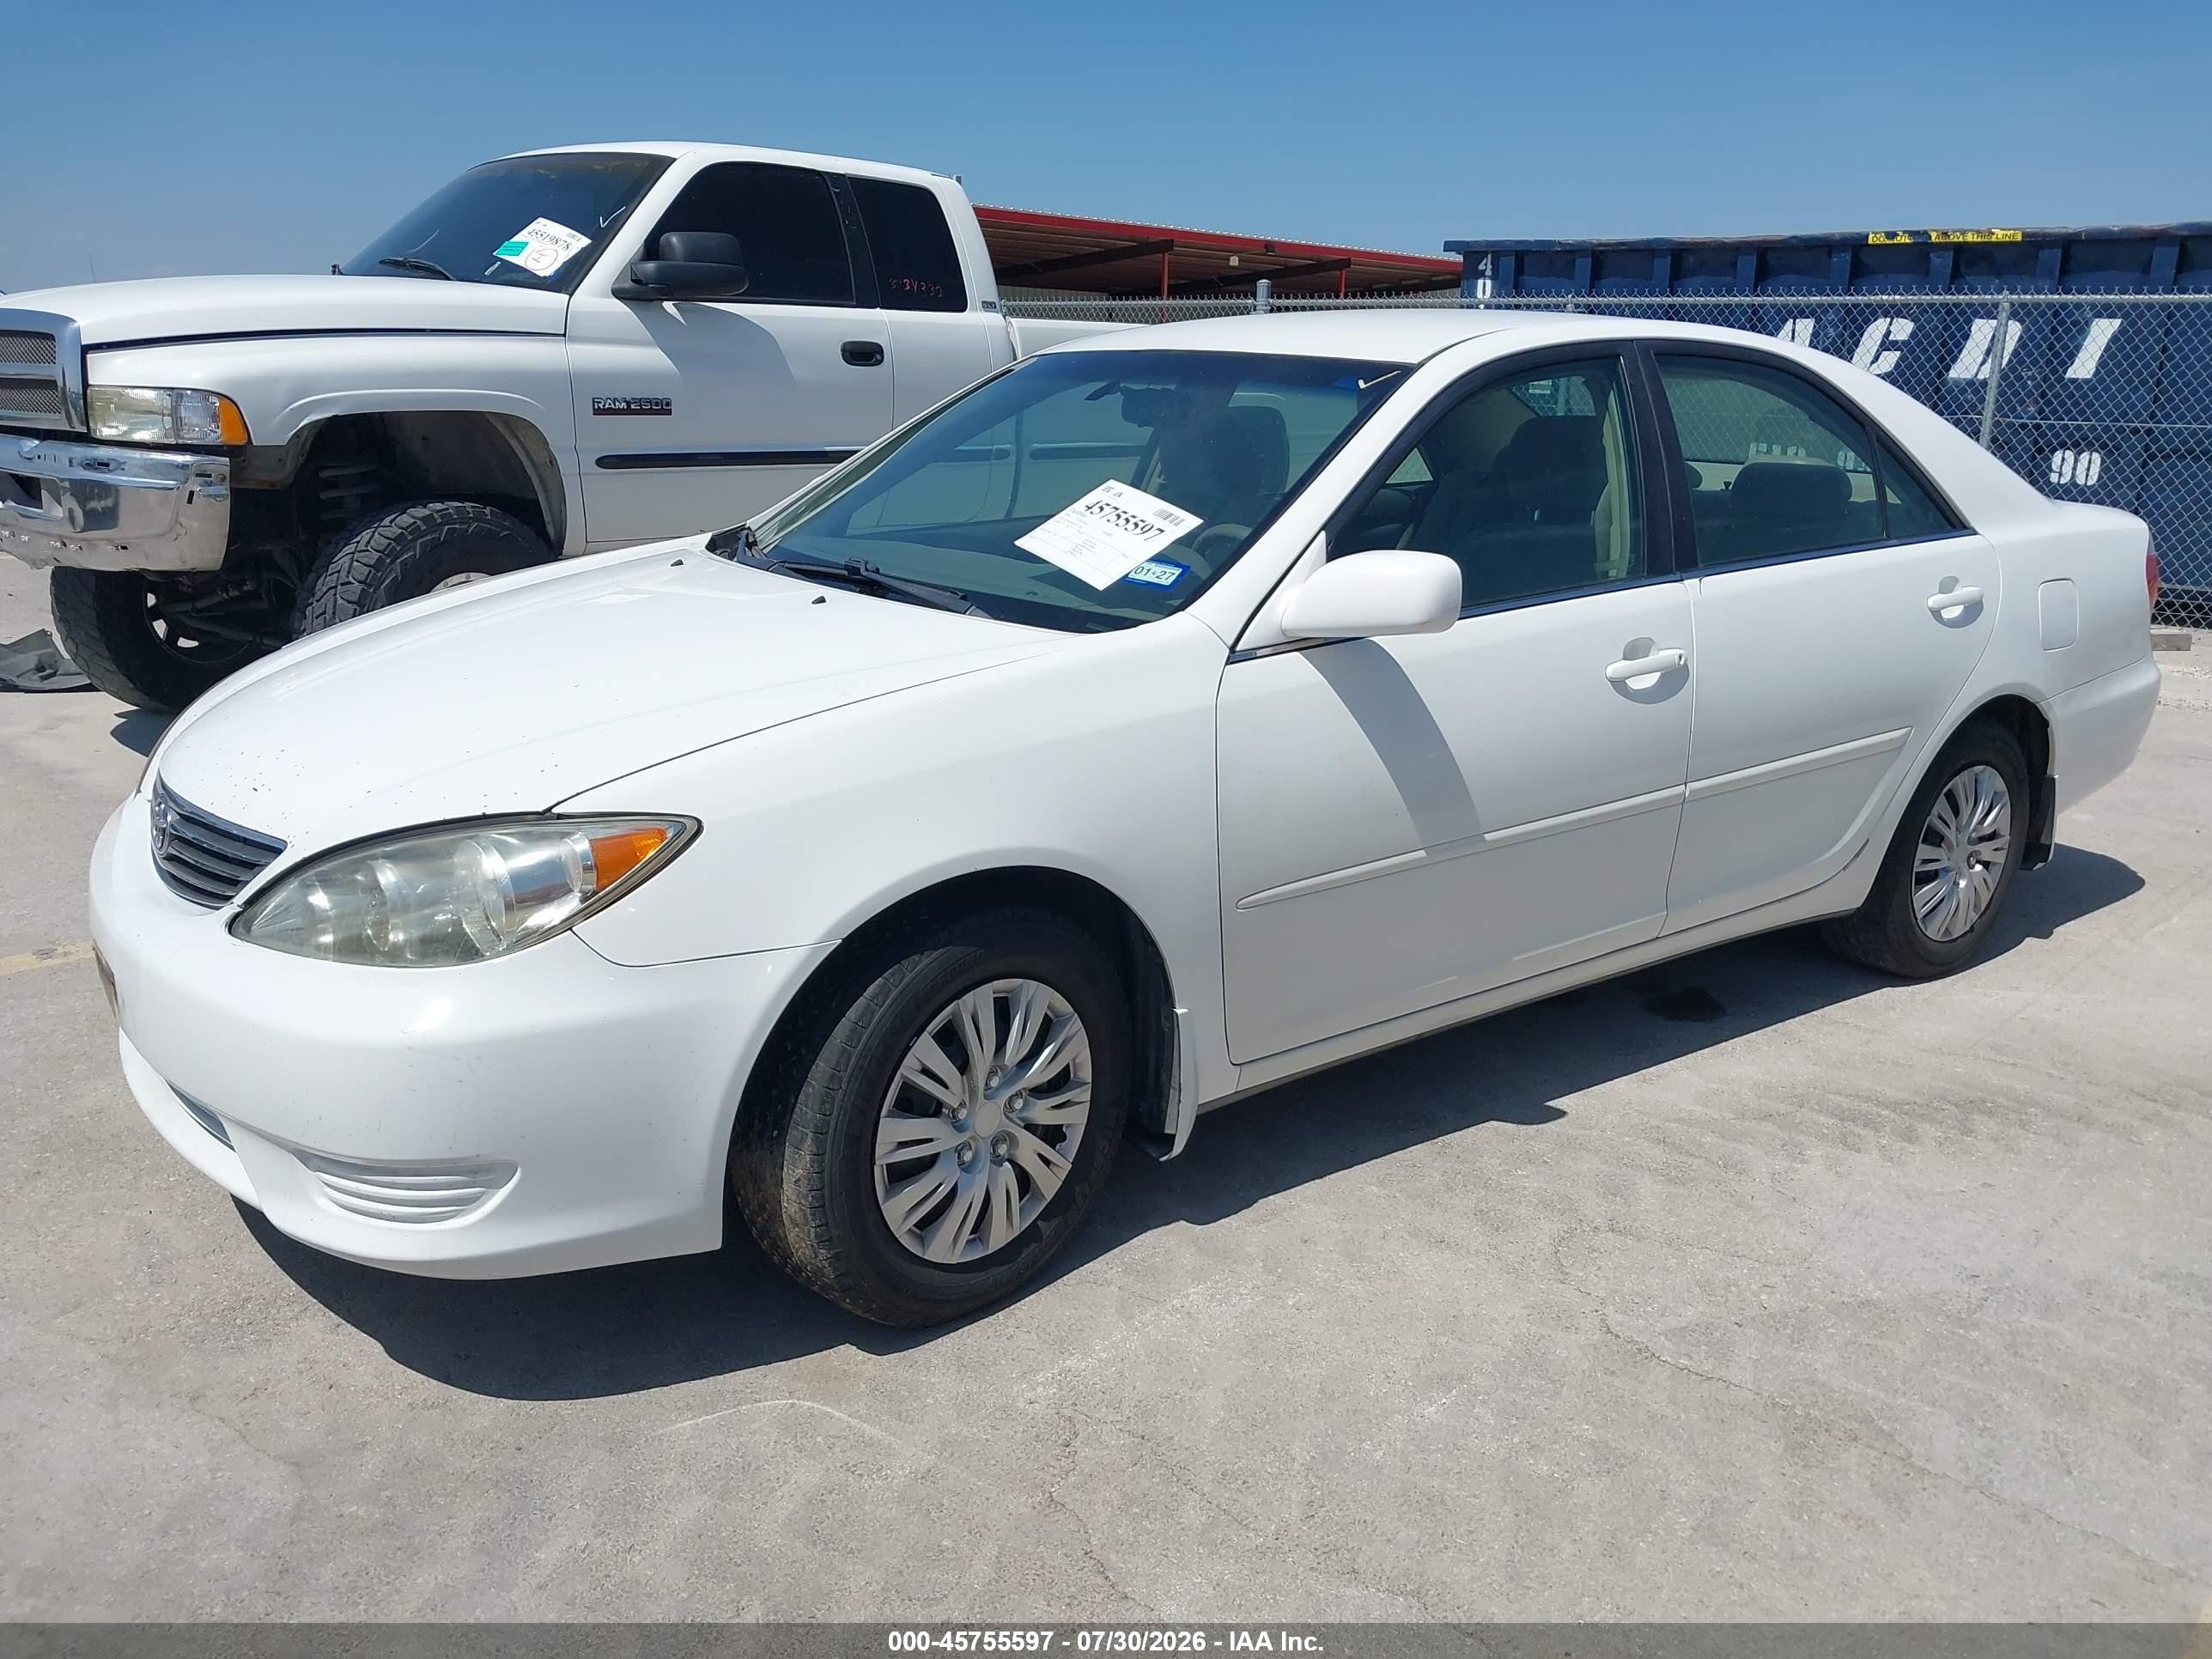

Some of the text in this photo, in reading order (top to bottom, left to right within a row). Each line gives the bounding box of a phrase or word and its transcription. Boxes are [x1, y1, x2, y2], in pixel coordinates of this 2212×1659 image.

[527, 228, 573, 251] 45519878
[1871, 234, 1886, 243] DO
[1934, 233, 1968, 241] ABOVE
[593, 398, 672, 410] RAM 2500
[2051, 449, 2102, 486] 90
[1085, 500, 1166, 542] 45755597
[1133, 566, 1152, 576] 01
[1155, 570, 1176, 581] 27
